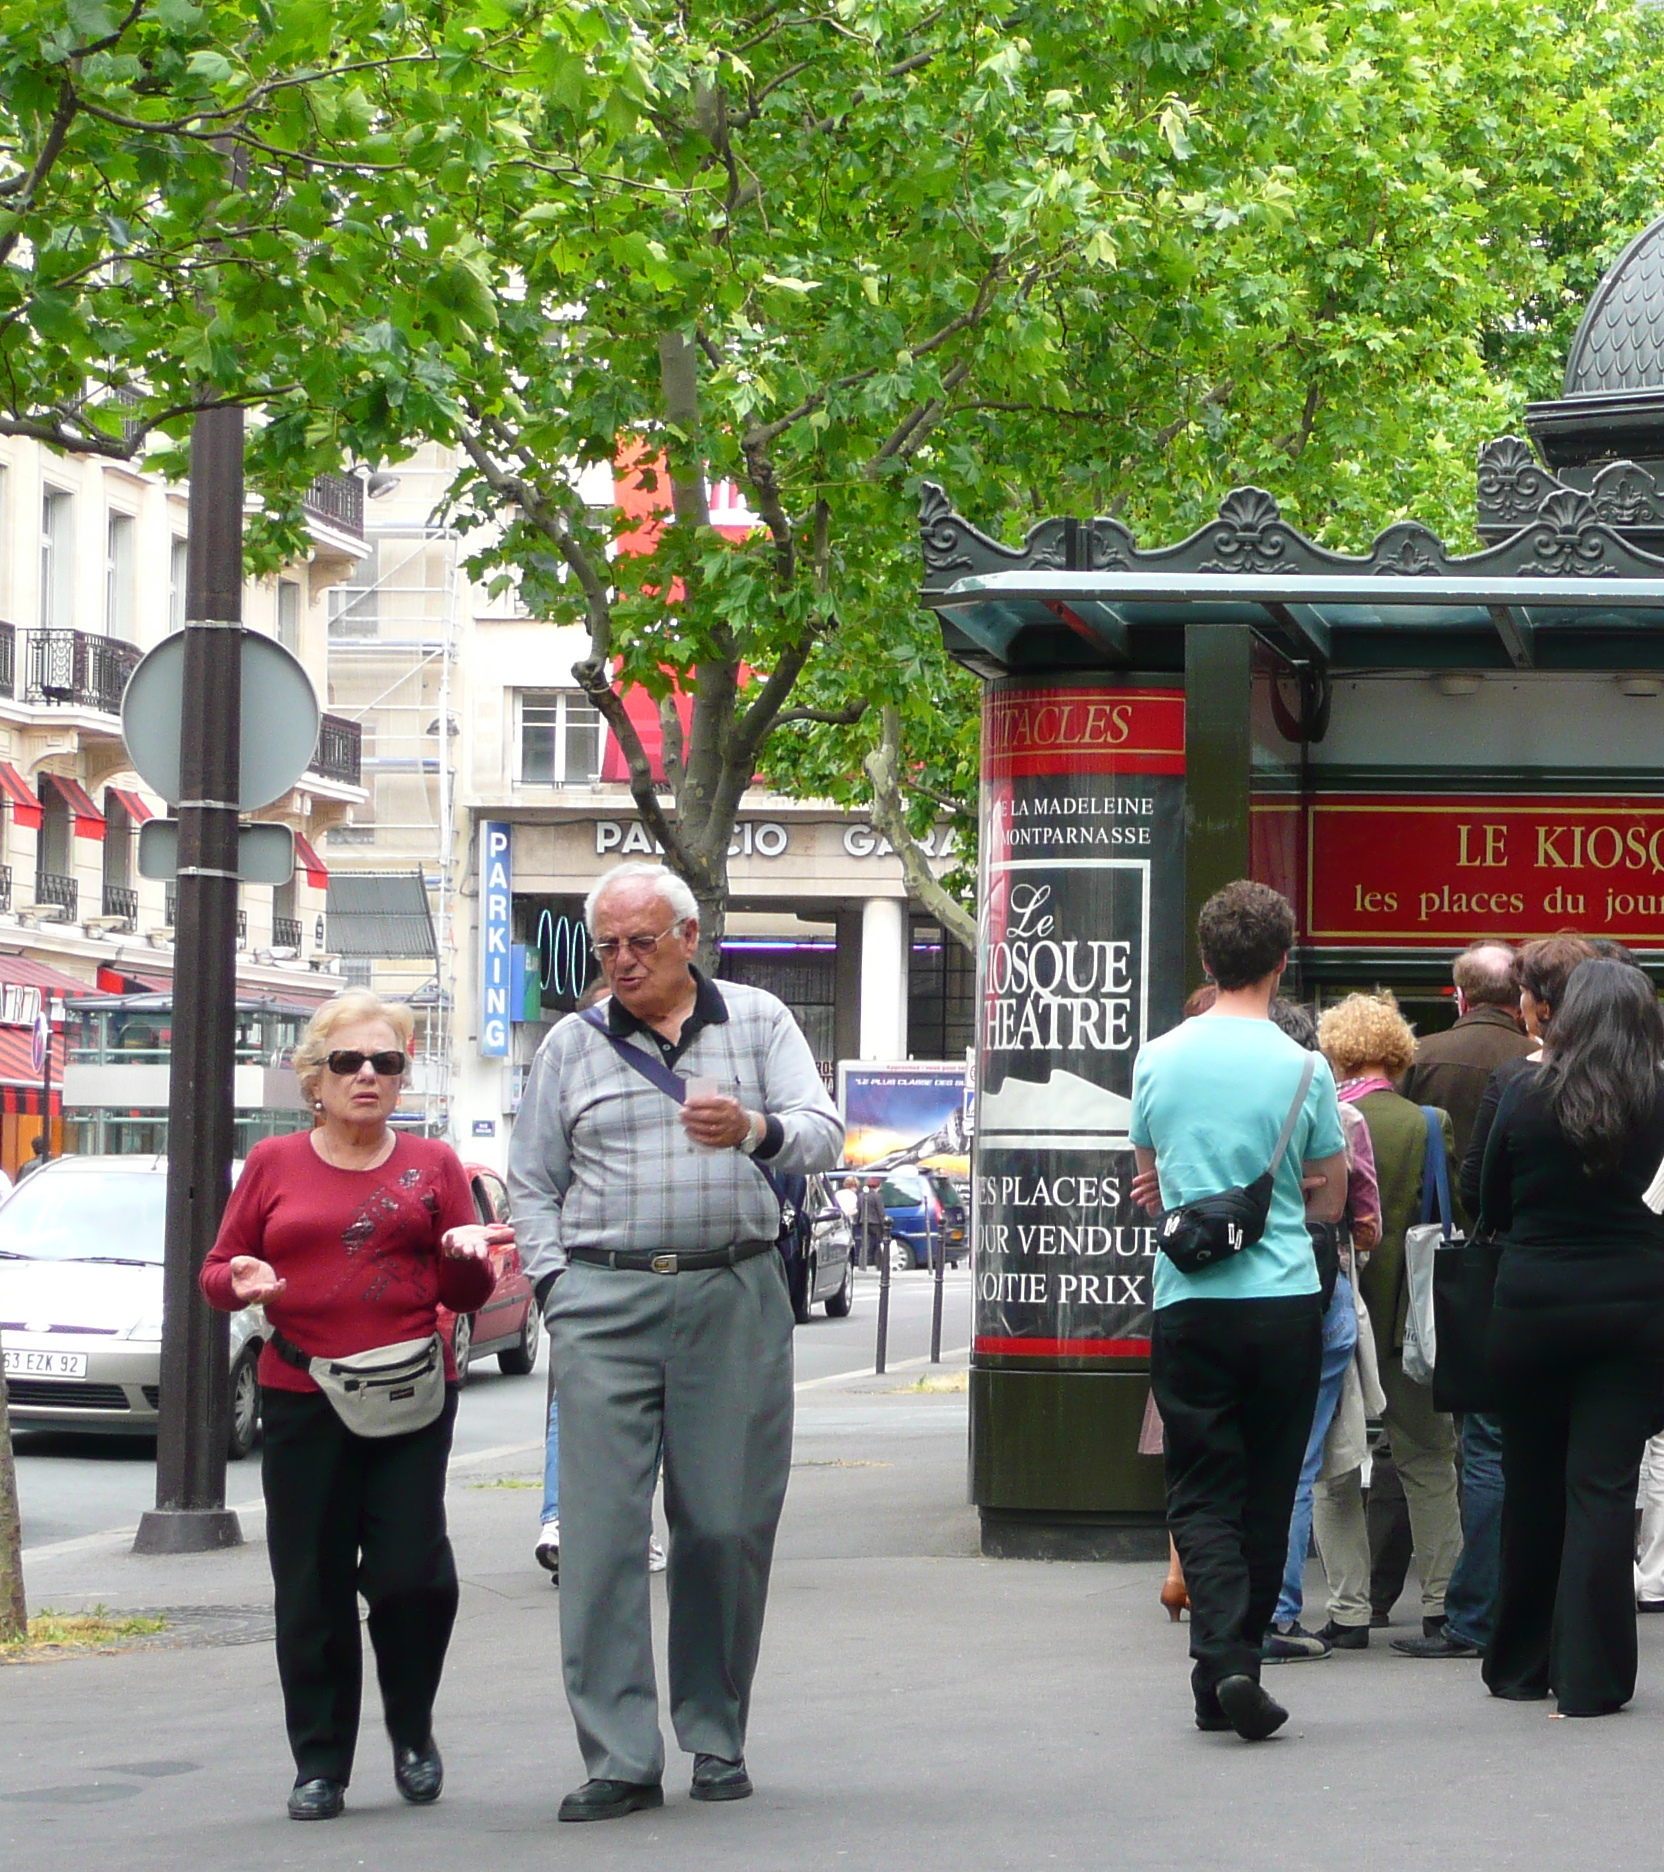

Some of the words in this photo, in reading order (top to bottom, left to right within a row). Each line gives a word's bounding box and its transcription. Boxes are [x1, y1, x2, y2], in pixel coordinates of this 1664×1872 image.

[989, 704, 1133, 748] TACLES
[1011, 798, 1029, 816] LA
[1034, 797, 1154, 816] MADELEINE
[596, 821, 787, 856] PACIO
[1456, 824, 1508, 868] LE
[1006, 883, 1055, 938] Le
[1354, 884, 1398, 912] les
[1418, 885, 1524, 921] places
[1543, 886, 1586, 915] du
[485, 832, 508, 1047] PARKING
[985, 940, 1133, 1001] IOSQUE
[984, 998, 1133, 1051] HEATRE
[977, 1176, 997, 1206] ES
[1002, 1176, 1121, 1207] PLACES
[978, 1224, 1010, 1254] OUR
[1017, 1225, 1157, 1256] VENDUE
[1058, 1274, 1146, 1305] PRIX
[27, 1353, 53, 1371] EZK
[60, 1356, 78, 1373] 92
